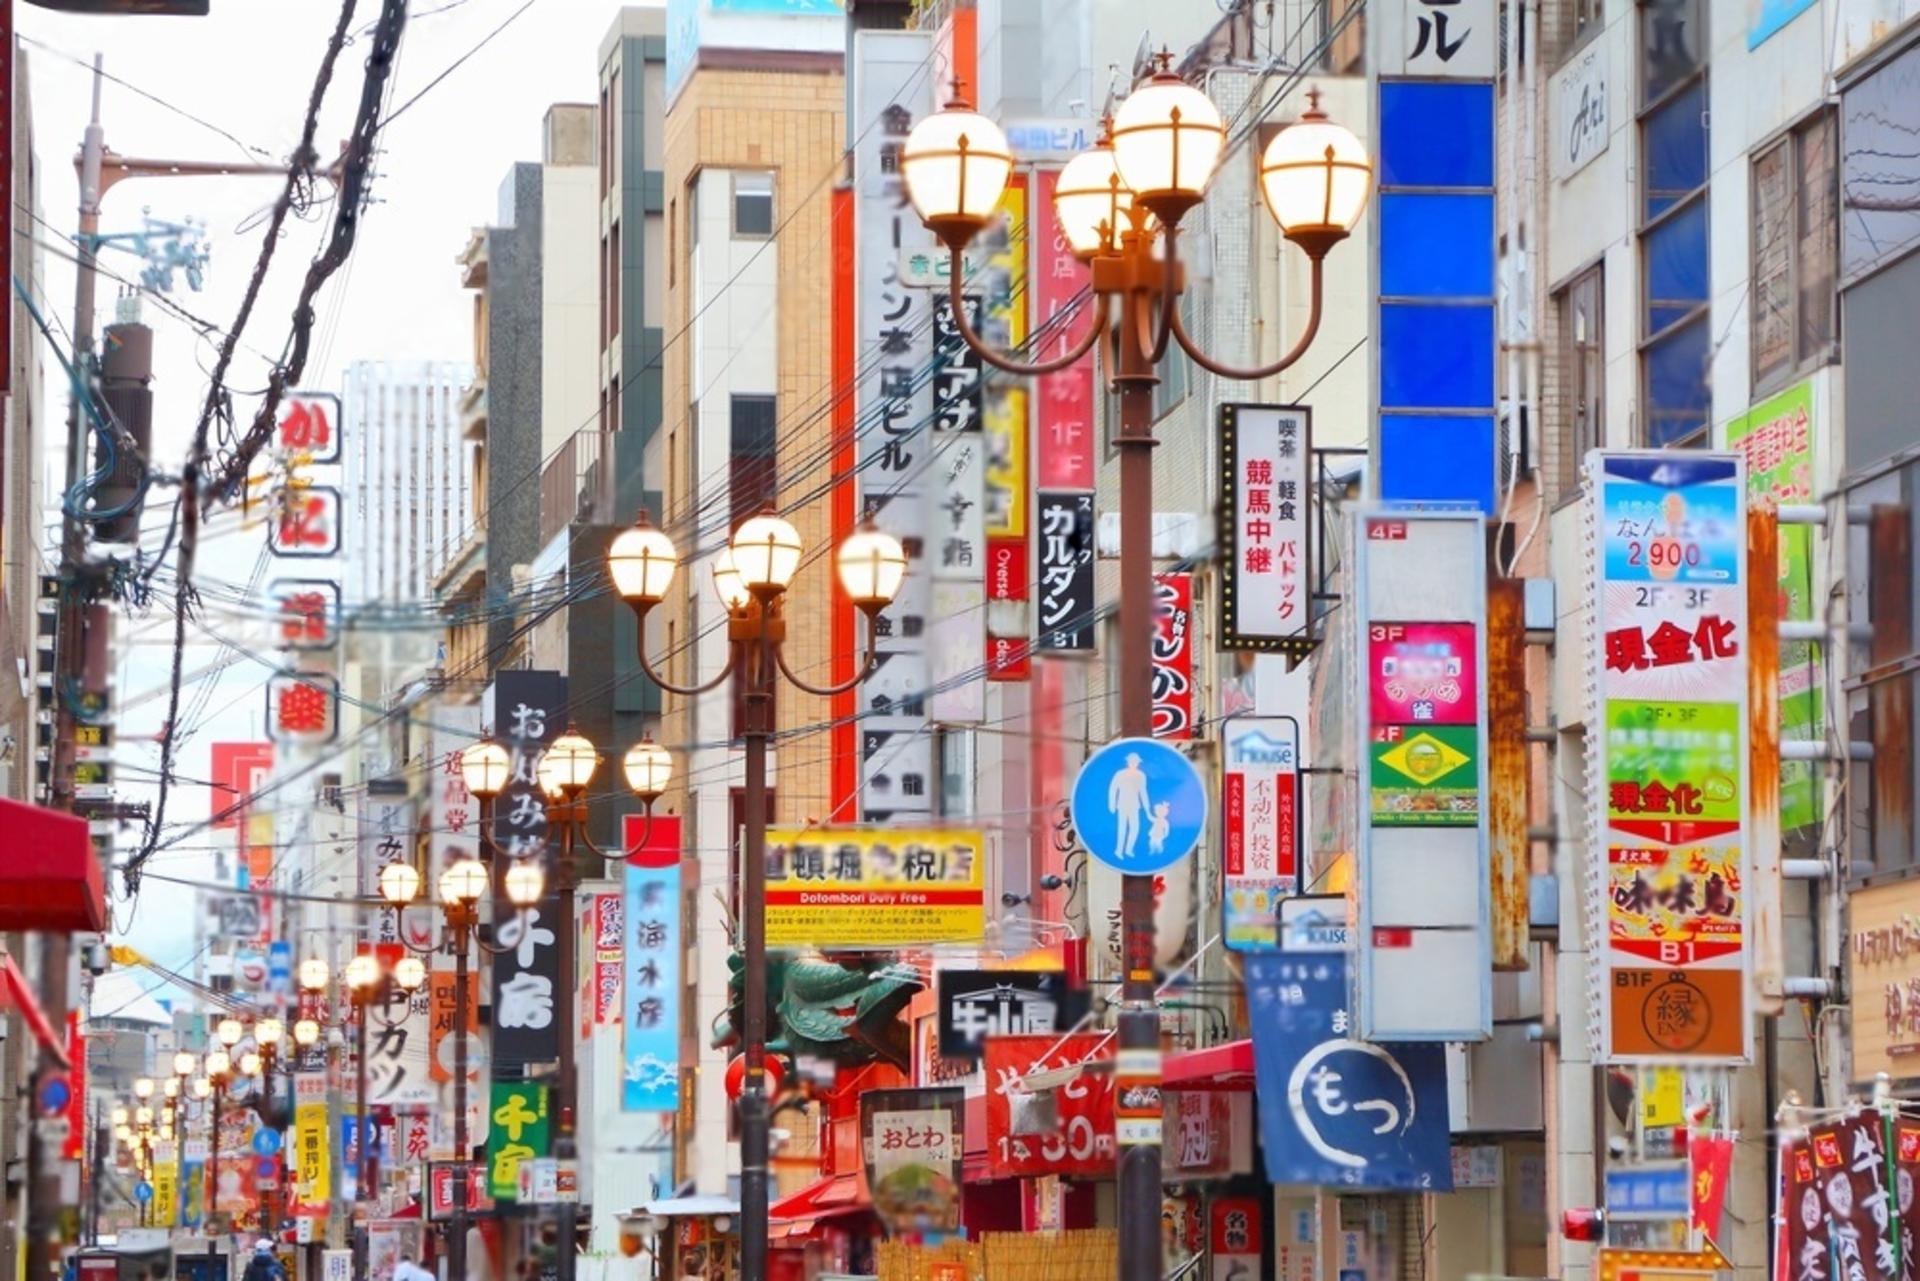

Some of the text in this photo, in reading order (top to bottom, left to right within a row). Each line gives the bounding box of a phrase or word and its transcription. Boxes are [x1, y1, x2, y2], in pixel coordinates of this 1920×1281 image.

[1410, 0, 1471, 62] ル
[1245, 459, 1273, 573] 競馬中継
[1371, 525, 1403, 539] 4F
[1042, 505, 1077, 626] カルダン
[1278, 540, 1297, 620] パドック
[1371, 626, 1403, 642] 3F
[1605, 614, 1738, 674] 現金化
[1609, 780, 1703, 815] 現金化
[1660, 942, 1695, 962] B1
[1615, 972, 1653, 987] B1F
[882, 1126, 944, 1150] おとわ
